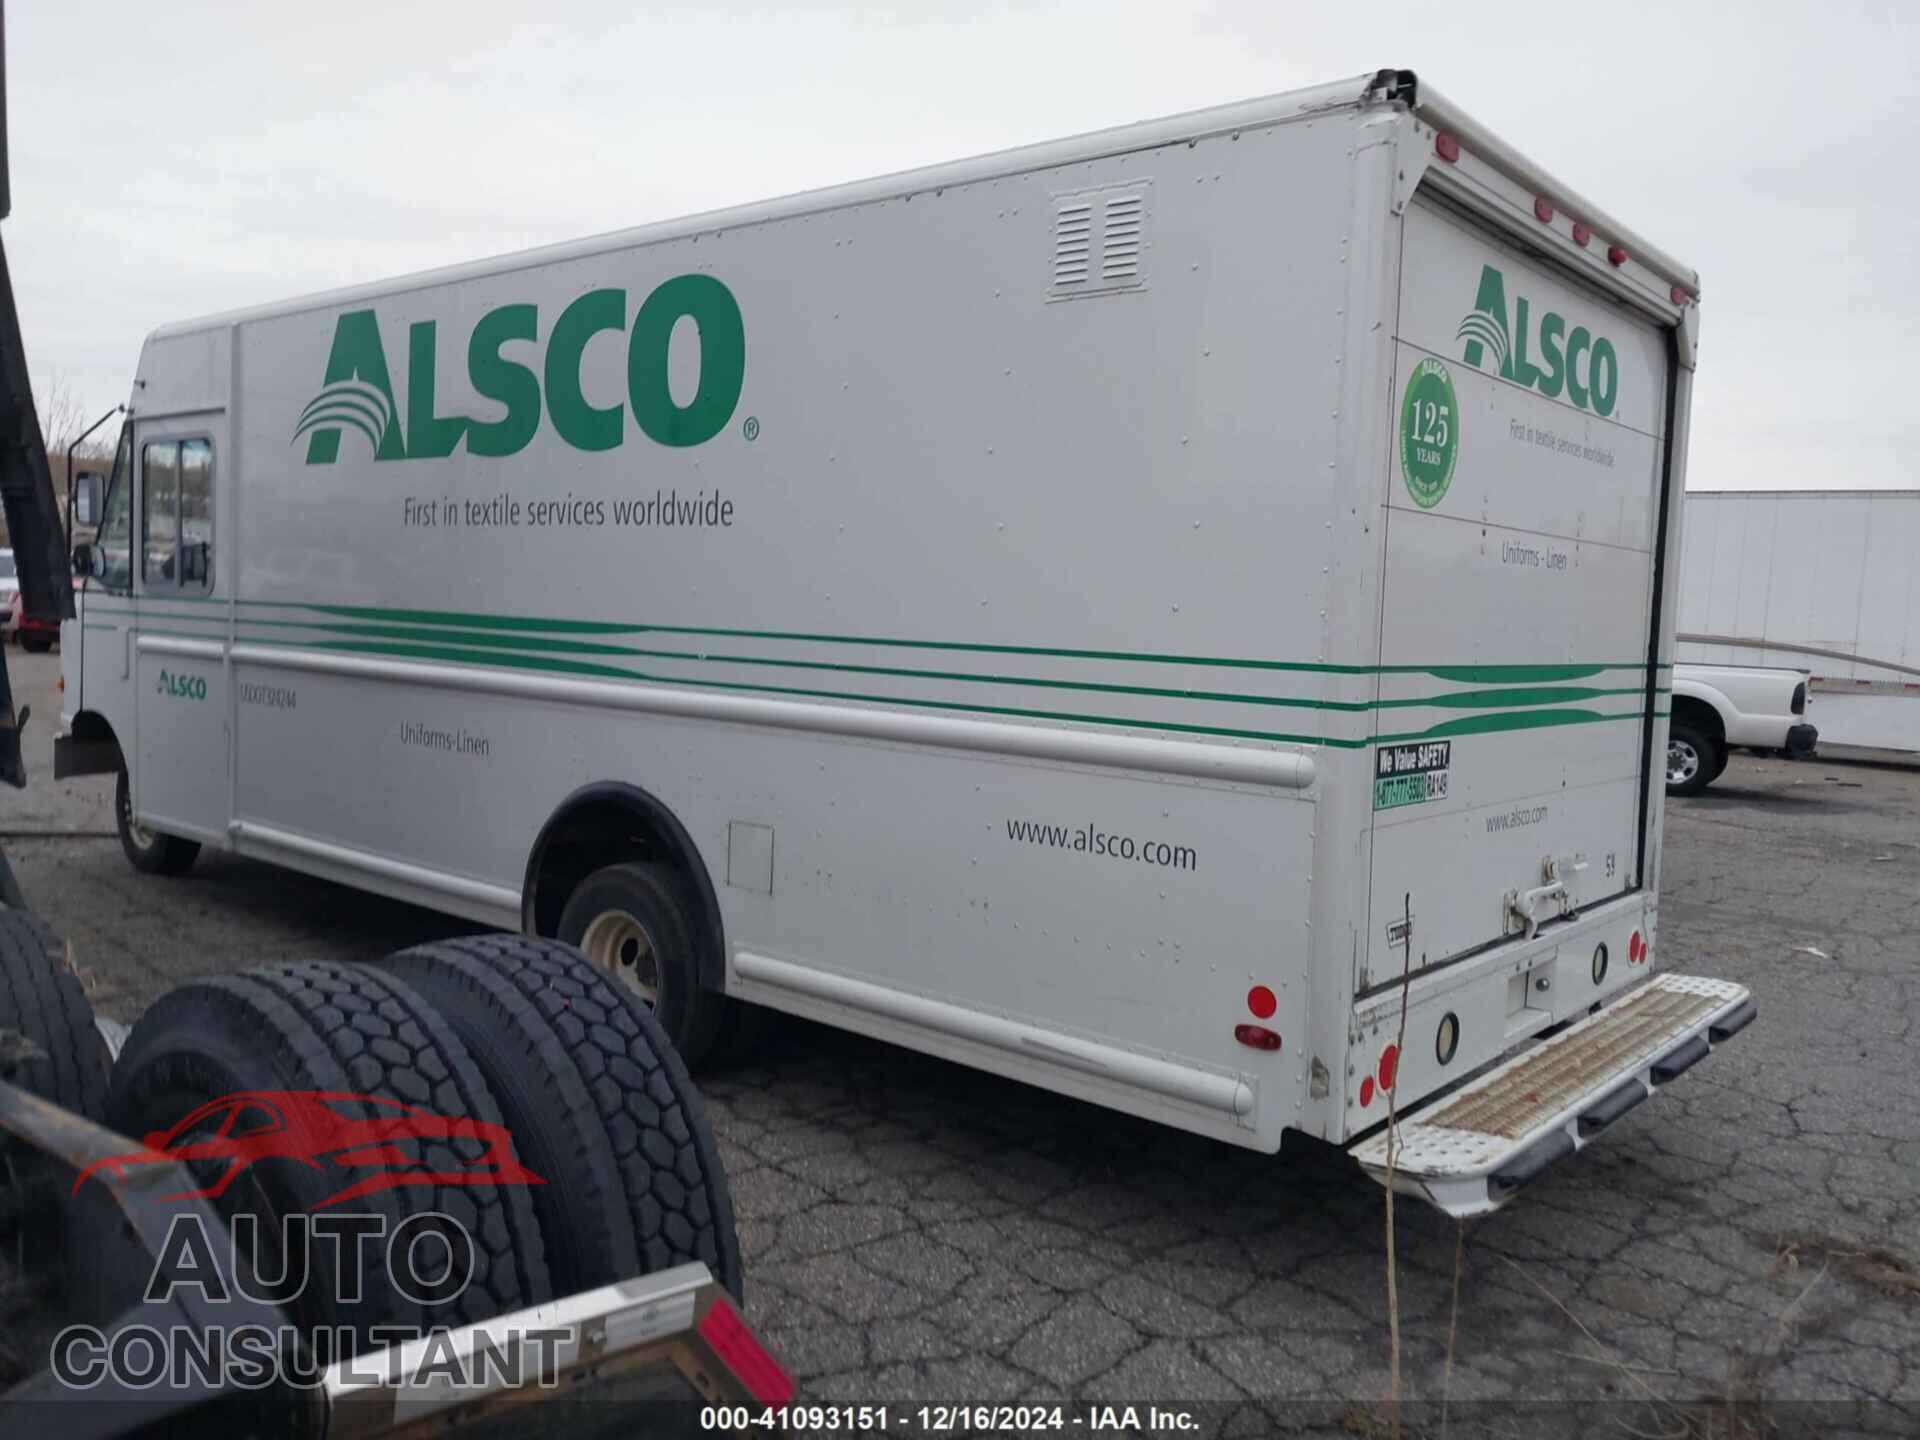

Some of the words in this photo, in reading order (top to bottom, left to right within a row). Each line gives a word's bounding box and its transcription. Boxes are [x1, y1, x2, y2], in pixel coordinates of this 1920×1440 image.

[1455, 264, 1618, 417] ALSCO
[290, 274, 746, 464] ALSCO
[1411, 398, 1449, 447] 125
[1416, 447, 1441, 466] YEARS
[404, 496, 437, 527] First
[443, 495, 458, 527] in
[464, 493, 520, 527] textile
[527, 491, 605, 527] services
[613, 489, 734, 527] worldwide
[1502, 540, 1540, 568] Uniforms
[1546, 547, 1567, 570] Linen
[157, 668, 207, 700] ALSCO
[400, 721, 489, 756] Uniforms-Linen
[1379, 748, 1393, 774] We
[1394, 747, 1417, 772] Value
[1417, 743, 1449, 769] SAFETY
[1486, 804, 1548, 832] www.alsco.com
[1006, 819, 1197, 871] www.alsco.com
